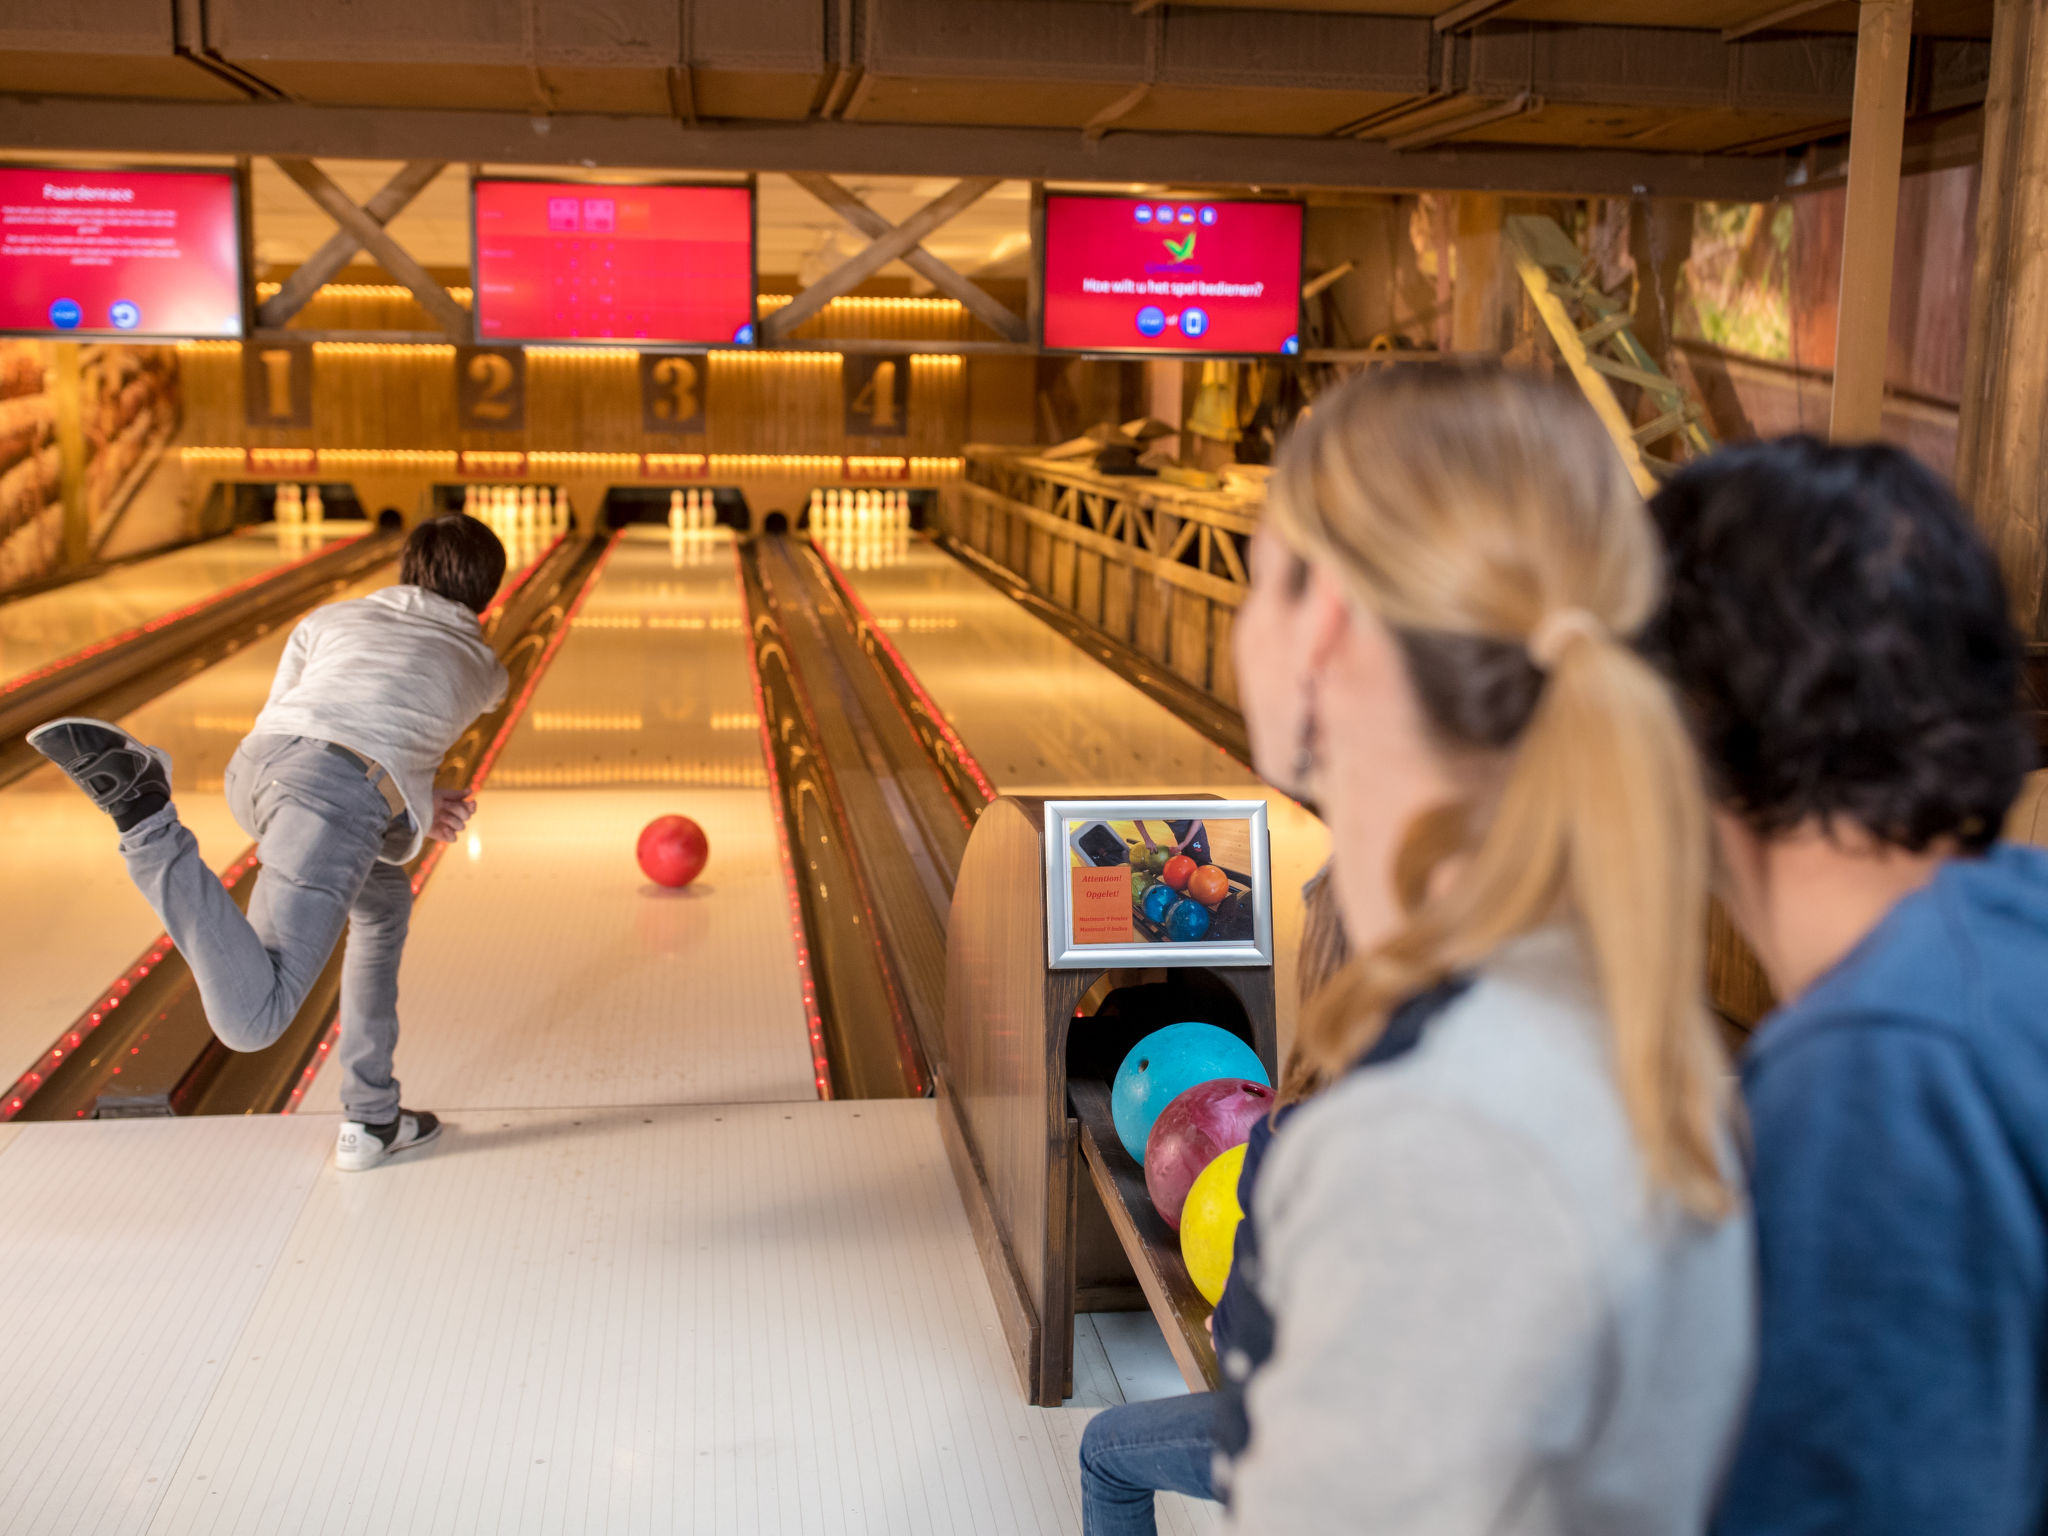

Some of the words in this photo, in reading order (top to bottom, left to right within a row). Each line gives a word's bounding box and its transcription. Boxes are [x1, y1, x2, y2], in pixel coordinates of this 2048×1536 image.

[1083, 278, 1110, 293] Hoe
[1111, 278, 1135, 294] wilt
[1136, 281, 1146, 294] u
[1147, 278, 1169, 295] het
[1170, 280, 1197, 298] spel
[1198, 280, 1264, 297] bedienen?
[260, 350, 292, 417] 1
[468, 353, 513, 420] 2
[653, 357, 697, 422] 3
[851, 361, 900, 427] 4
[1086, 890, 1119, 899] Opgelet!
[341, 1134, 357, 1144] 40
